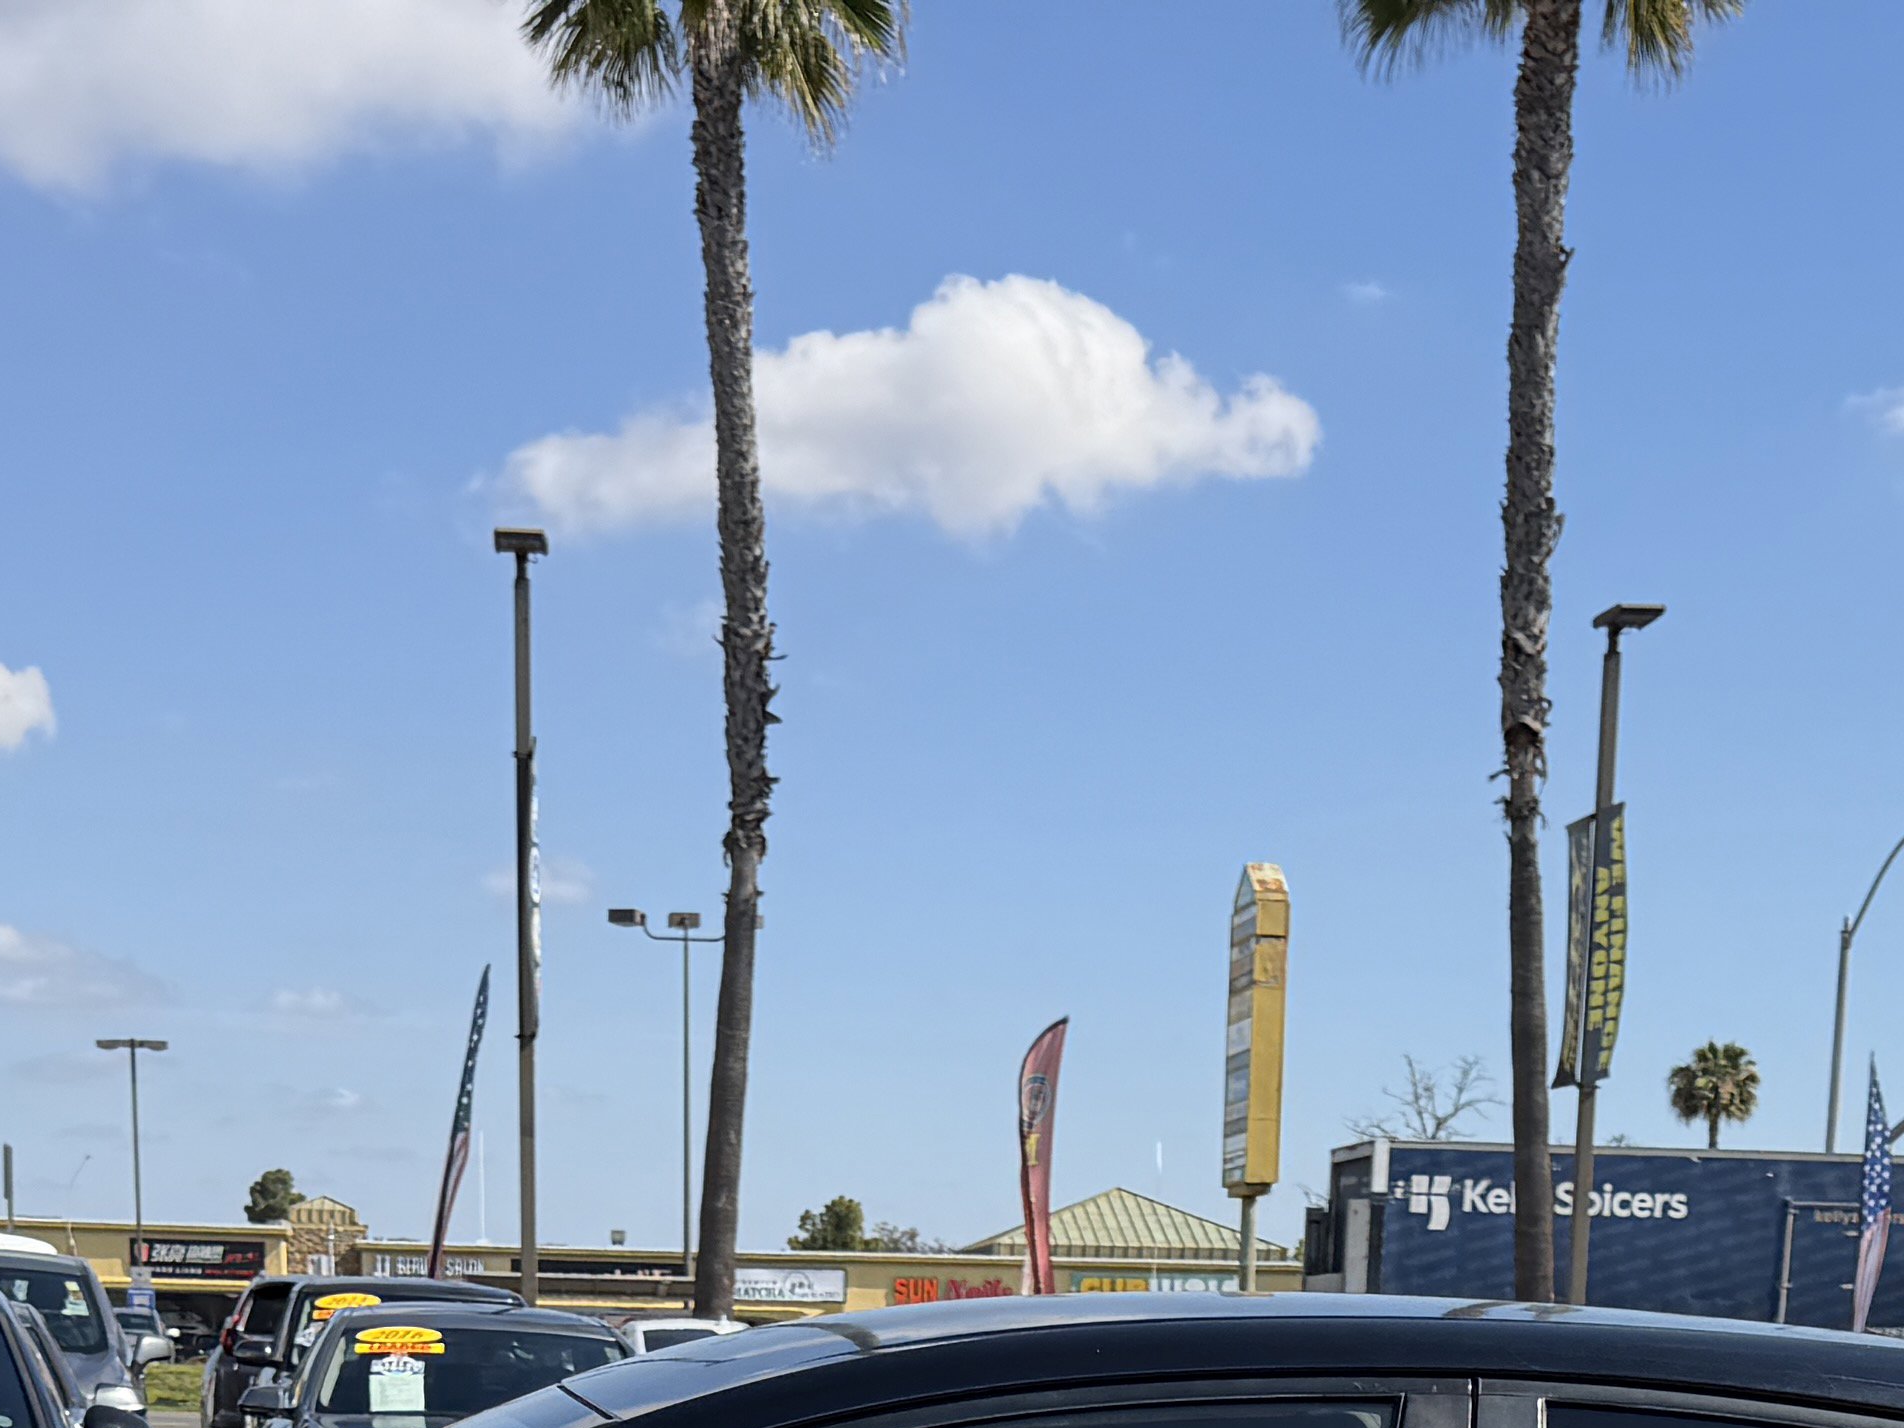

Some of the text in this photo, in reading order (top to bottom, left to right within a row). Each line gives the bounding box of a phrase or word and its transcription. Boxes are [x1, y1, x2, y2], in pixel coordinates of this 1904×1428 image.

[1610, 815, 1625, 885] WE
[1587, 866, 1611, 1032] ANYONE
[1462, 1178, 1516, 1215] Kel
[396, 1255, 429, 1277] BEAU
[895, 1278, 939, 1305] SUN
